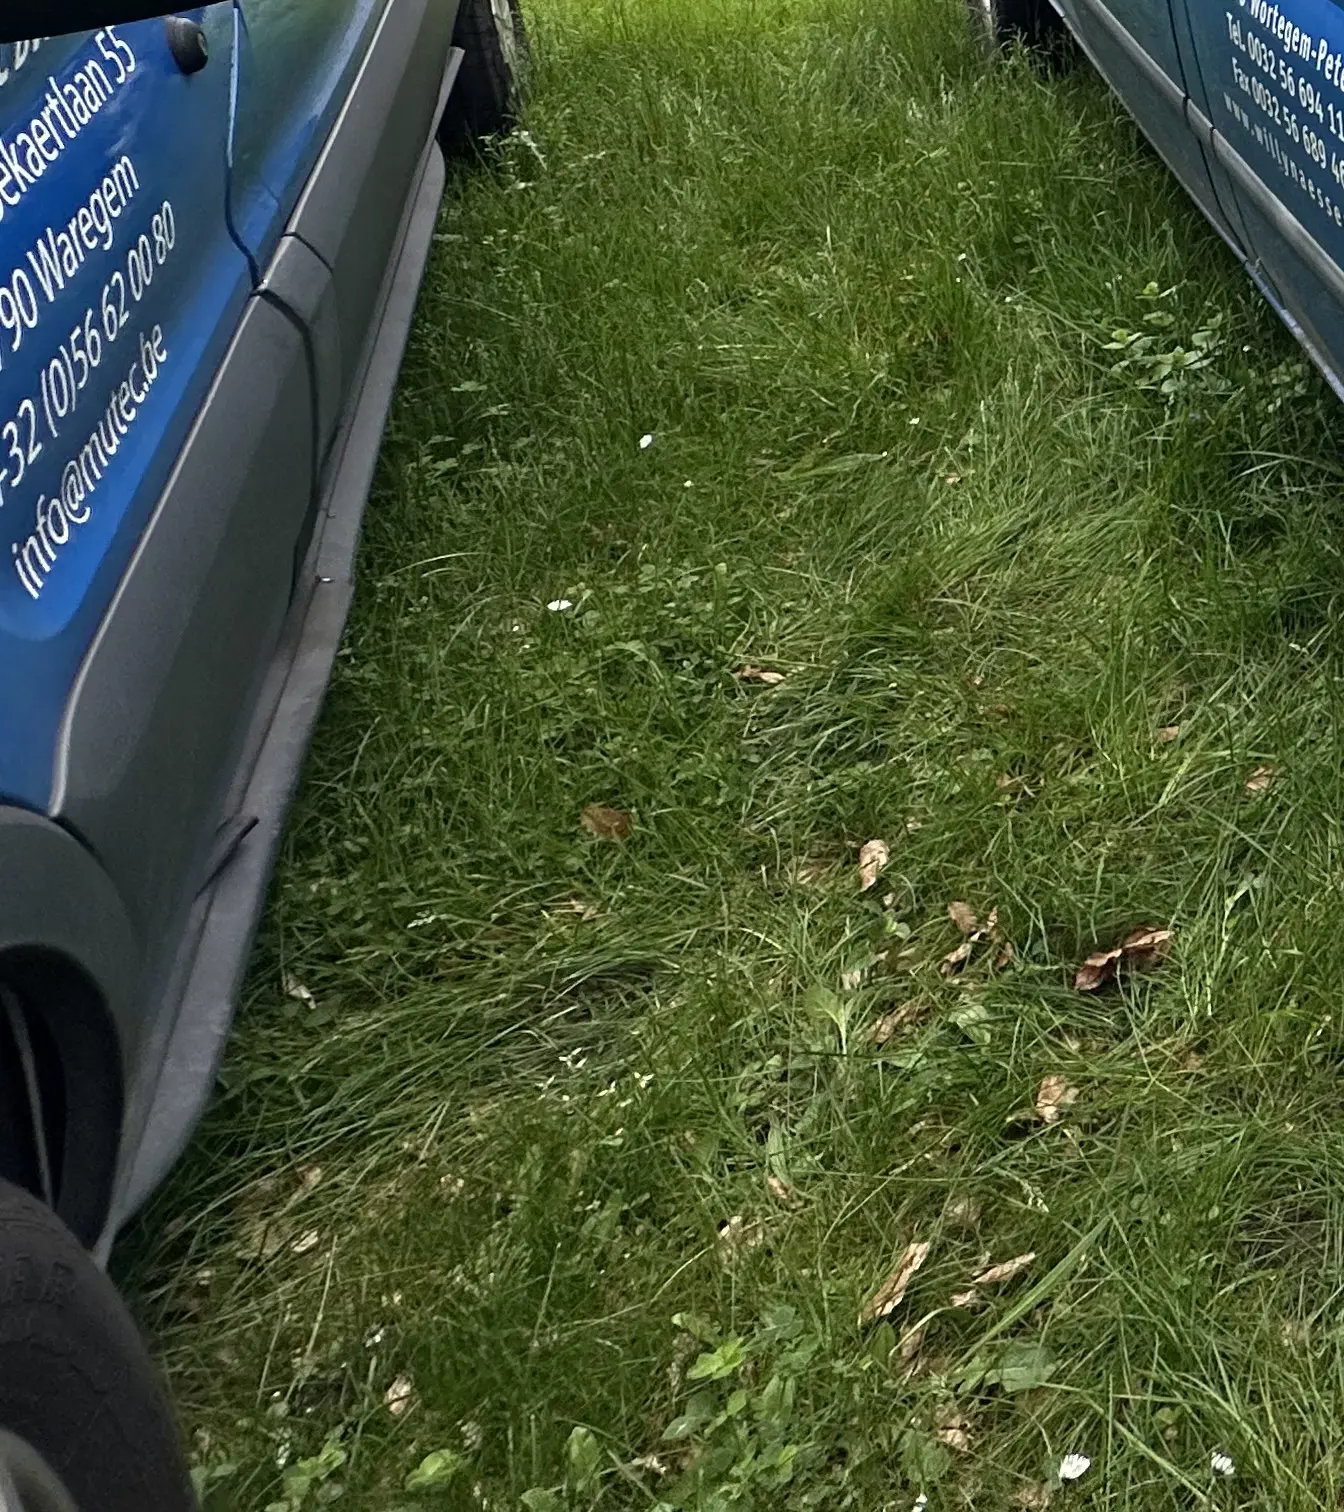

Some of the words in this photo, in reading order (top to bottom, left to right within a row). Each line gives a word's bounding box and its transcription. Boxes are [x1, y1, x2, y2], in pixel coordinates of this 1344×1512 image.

[0, 59, 114, 222] ekaertlaan
[94, 25, 136, 85] 55
[1226, 11, 1246, 53] Tel.
[1247, 31, 1277, 81] 0032
[1279, 59, 1296, 97] 56
[1299, 76, 1324, 124] 694
[1231, 56, 1252, 97] Fax
[1251, 76, 1282, 126] 0032
[1283, 105, 1300, 143] 56
[1302, 124, 1327, 170] 689
[0, 268, 38, 372] 90
[26, 155, 140, 303] Waregem
[102, 271, 130, 342] 62
[127, 234, 153, 302] 00
[152, 200, 176, 266] 80
[11, 324, 168, 600] info@mutec.be
